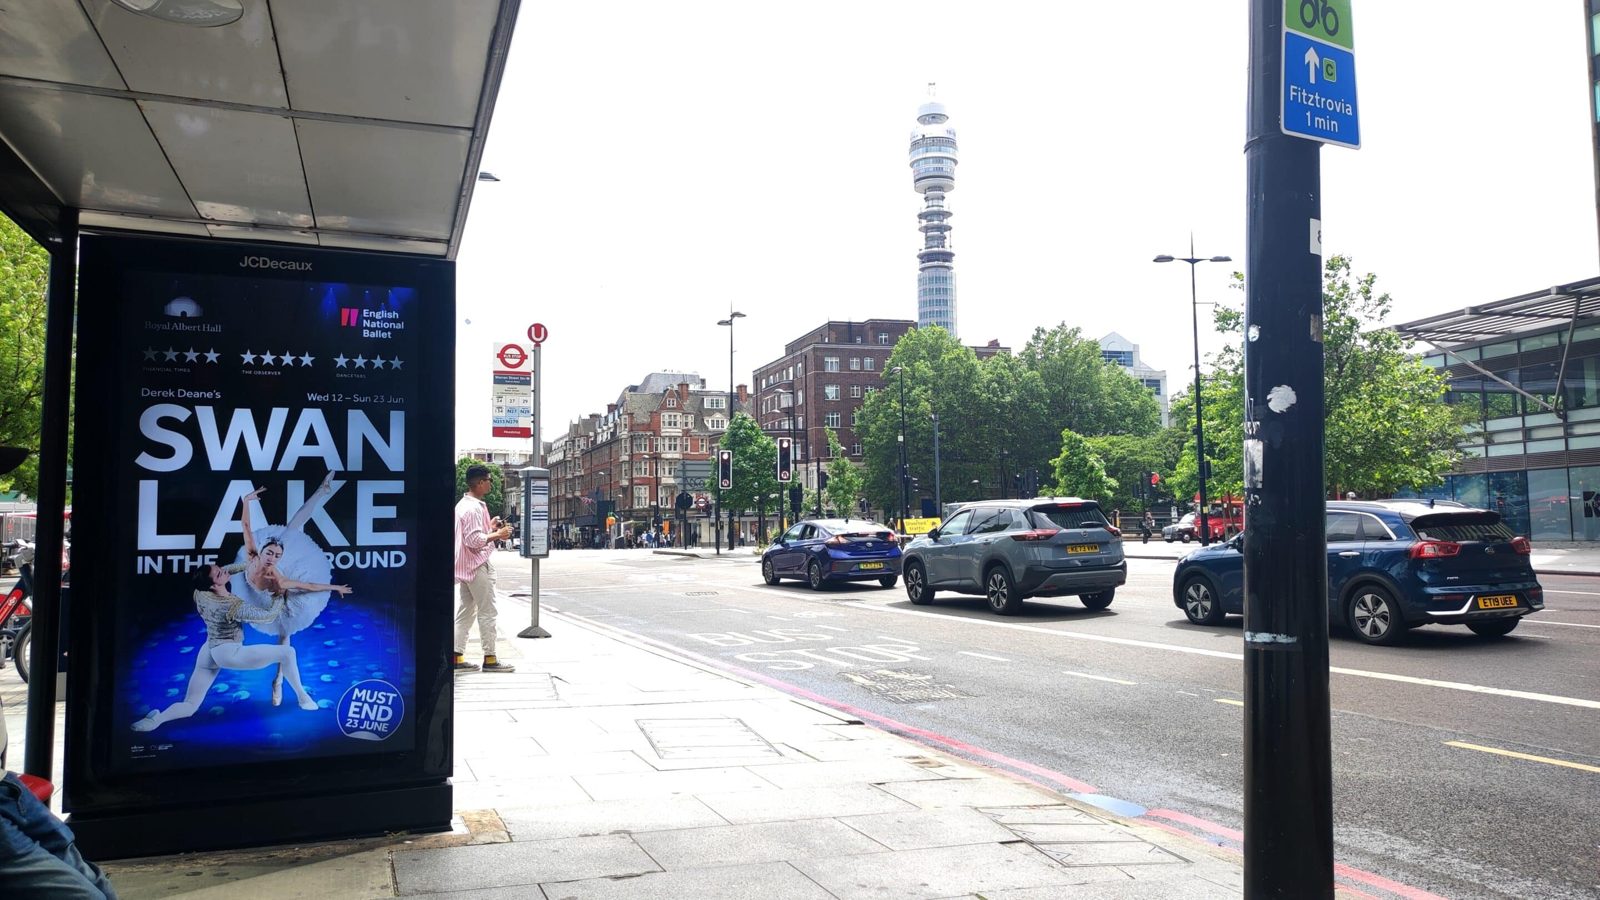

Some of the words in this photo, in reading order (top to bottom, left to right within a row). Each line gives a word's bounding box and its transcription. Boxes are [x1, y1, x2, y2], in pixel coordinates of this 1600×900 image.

[1290, 85, 1353, 116] Fitztrovia
[1306, 111, 1311, 126] 1
[1315, 116, 1338, 132] min
[240, 256, 313, 271] JCDecaux
[363, 309, 399, 320] English
[145, 320, 170, 332] Royal
[171, 322, 201, 332] Albert
[202, 323, 222, 333] Hall
[363, 319, 404, 330] National
[363, 329, 392, 339] Ballet
[141, 388, 175, 398] Derek
[177, 389, 221, 399] Deane's
[307, 392, 329, 402] Wed
[332, 393, 343, 402] 12
[353, 394, 371, 403] Sun
[373, 395, 385, 403] 23
[387, 395, 404, 404] Jun
[134, 403, 405, 472] SWAN
[137, 479, 407, 551] LAKE
[137, 556, 166, 574] IN
[1500, 597, 1514, 606] UEE
[688, 628, 834, 647] BUS
[734, 644, 932, 671] STOP
[352, 688, 397, 706] MUST
[348, 701, 393, 722] END
[345, 718, 359, 728] 23
[360, 720, 389, 733] JUNE
